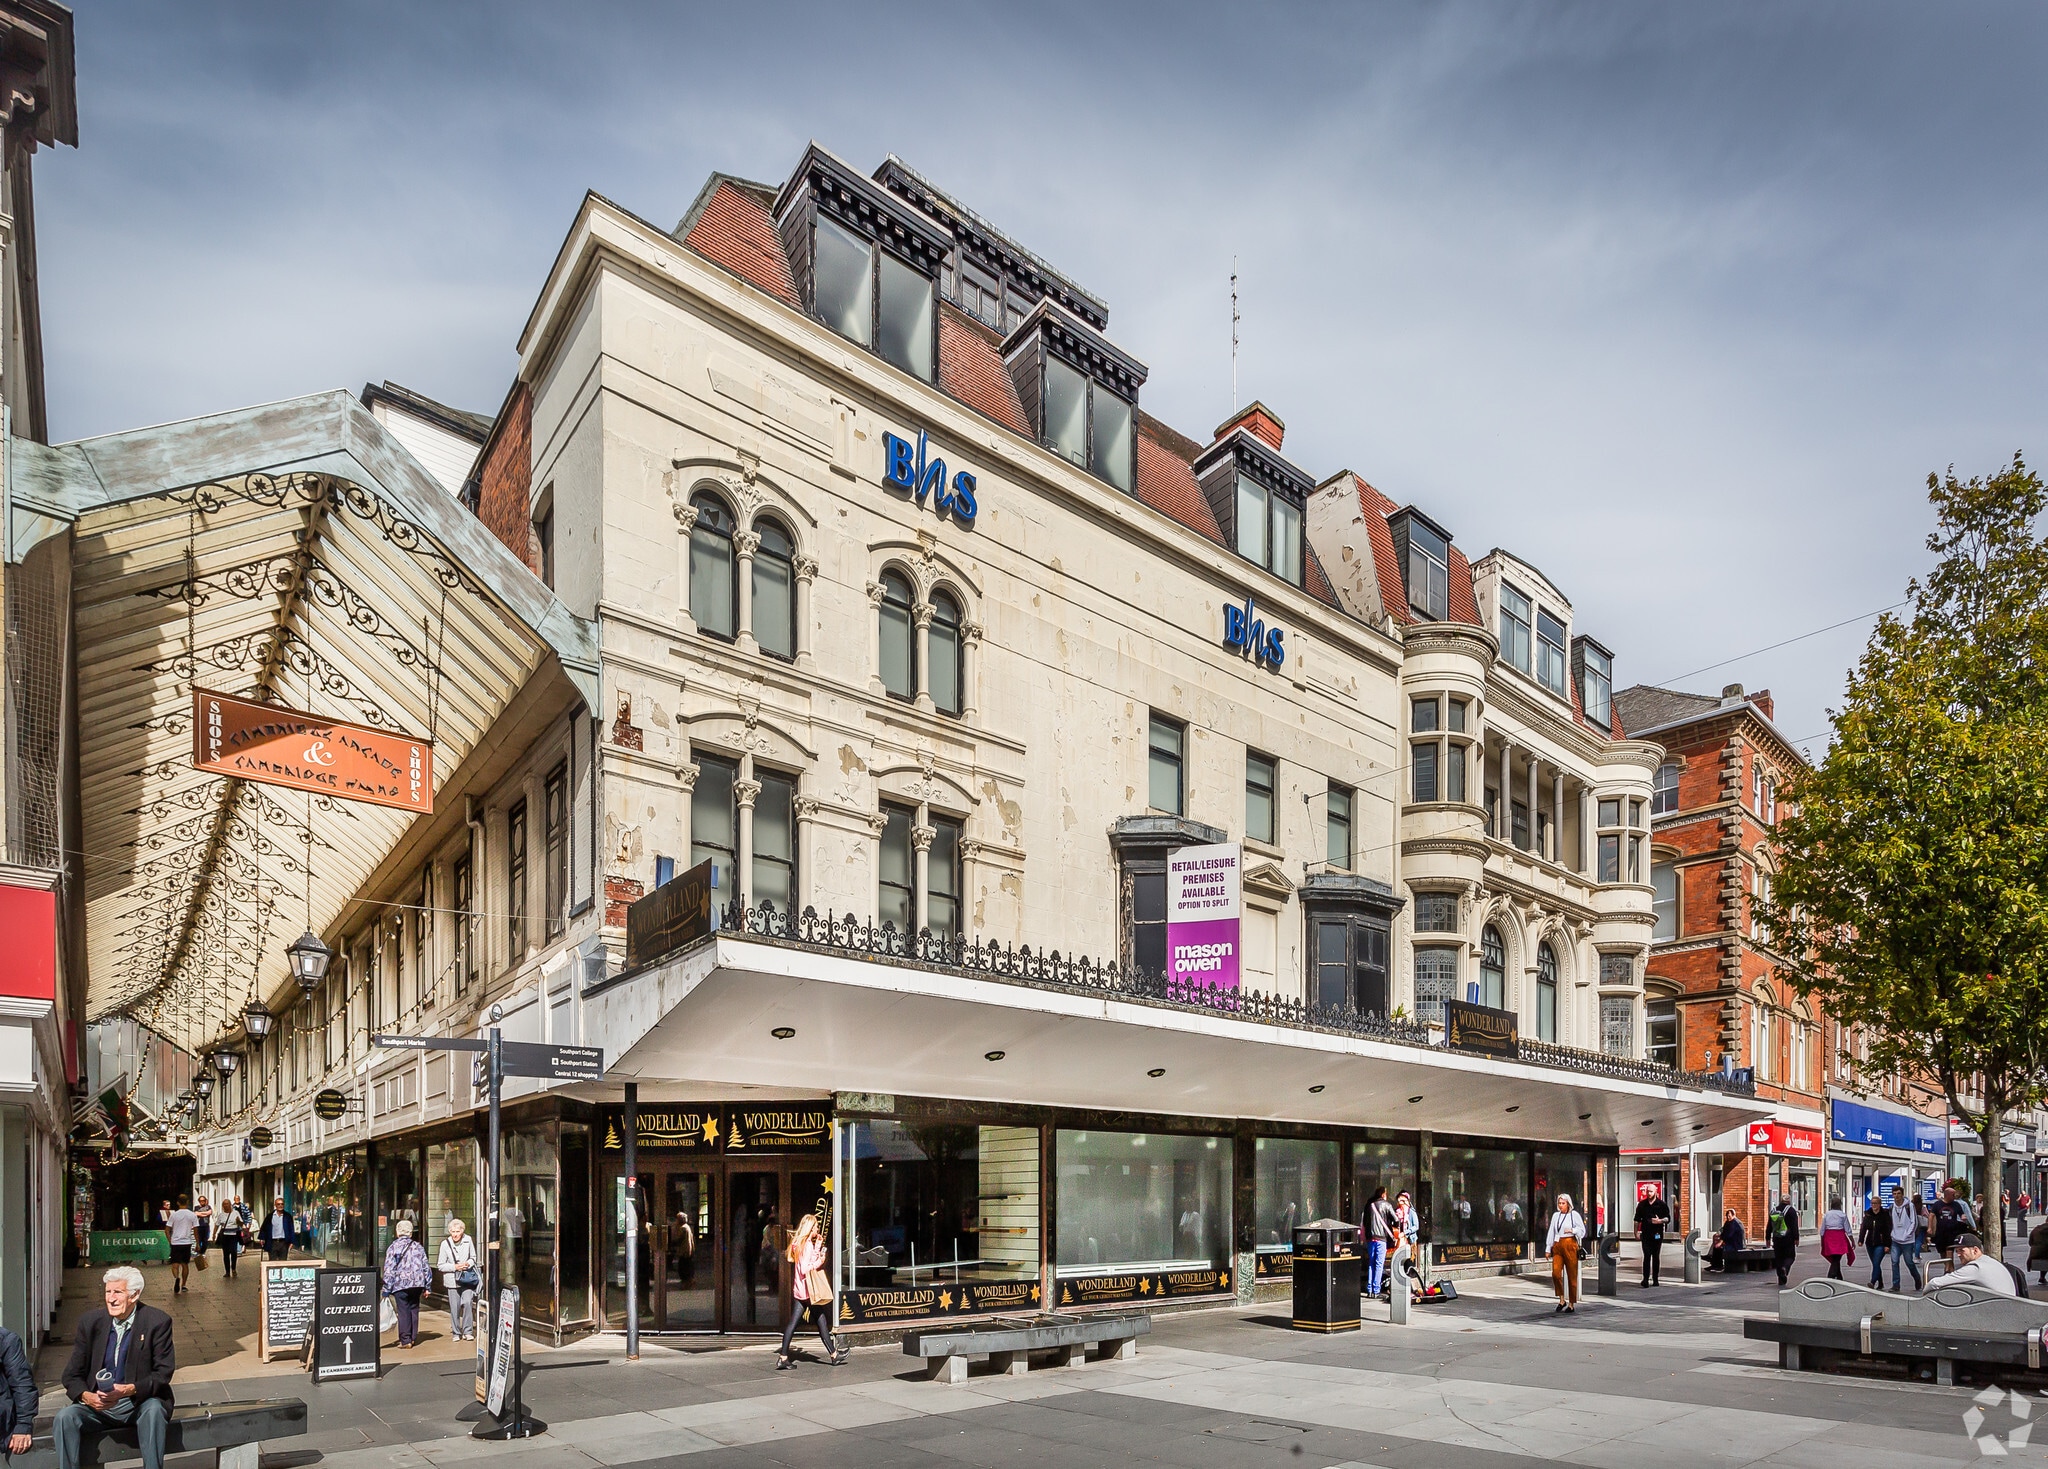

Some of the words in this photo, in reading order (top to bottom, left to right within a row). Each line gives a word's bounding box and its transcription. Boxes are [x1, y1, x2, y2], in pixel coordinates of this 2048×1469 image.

[208, 700, 223, 763] SHOPS
[302, 741, 337, 767] &
[409, 746, 422, 803] SHOPS
[1171, 857, 1236, 873] RETAIL/LEISURE
[1182, 872, 1225, 885] PREMISES
[1181, 886, 1226, 899] AVAILABLE
[1177, 900, 1201, 910] OPTION
[1202, 899, 1211, 908] TO
[1212, 898, 1230, 907] SPLIT
[1174, 942, 1233, 959] mason
[1174, 957, 1222, 973] owen
[1458, 1009, 1510, 1035] WONDERLAND
[381, 1038, 408, 1047] Southport
[408, 1039, 426, 1047] Market
[559, 1048, 581, 1056] Southport
[581, 1049, 598, 1058] College
[559, 1059, 582, 1067] Southport
[578, 1071, 598, 1079] shopping
[743, 1112, 825, 1130] WONDERLAND
[650, 1138, 679, 1147] CHRISTMAS
[679, 1139, 696, 1147] NEEDS
[750, 1138, 759, 1146] ALL
[759, 1138, 774, 1146] YOUR
[774, 1137, 803, 1146] CHRISTMAS
[803, 1137, 820, 1145] NEEDS
[1791, 1133, 1813, 1151] Santander
[102, 1238, 111, 1247] LE
[112, 1237, 159, 1247] BOULEVARD
[334, 1274, 362, 1284] FACE
[1076, 1276, 1137, 1291] WONDERLAND
[1167, 1271, 1217, 1285] WONDERLAND
[331, 1285, 366, 1296] VALUE
[973, 1283, 1028, 1298] WONDERLAND
[858, 1289, 935, 1306] WONDERLAND
[324, 1306, 343, 1315] CUT
[343, 1304, 372, 1314] PRICE
[321, 1323, 374, 1335] COSMETICS
